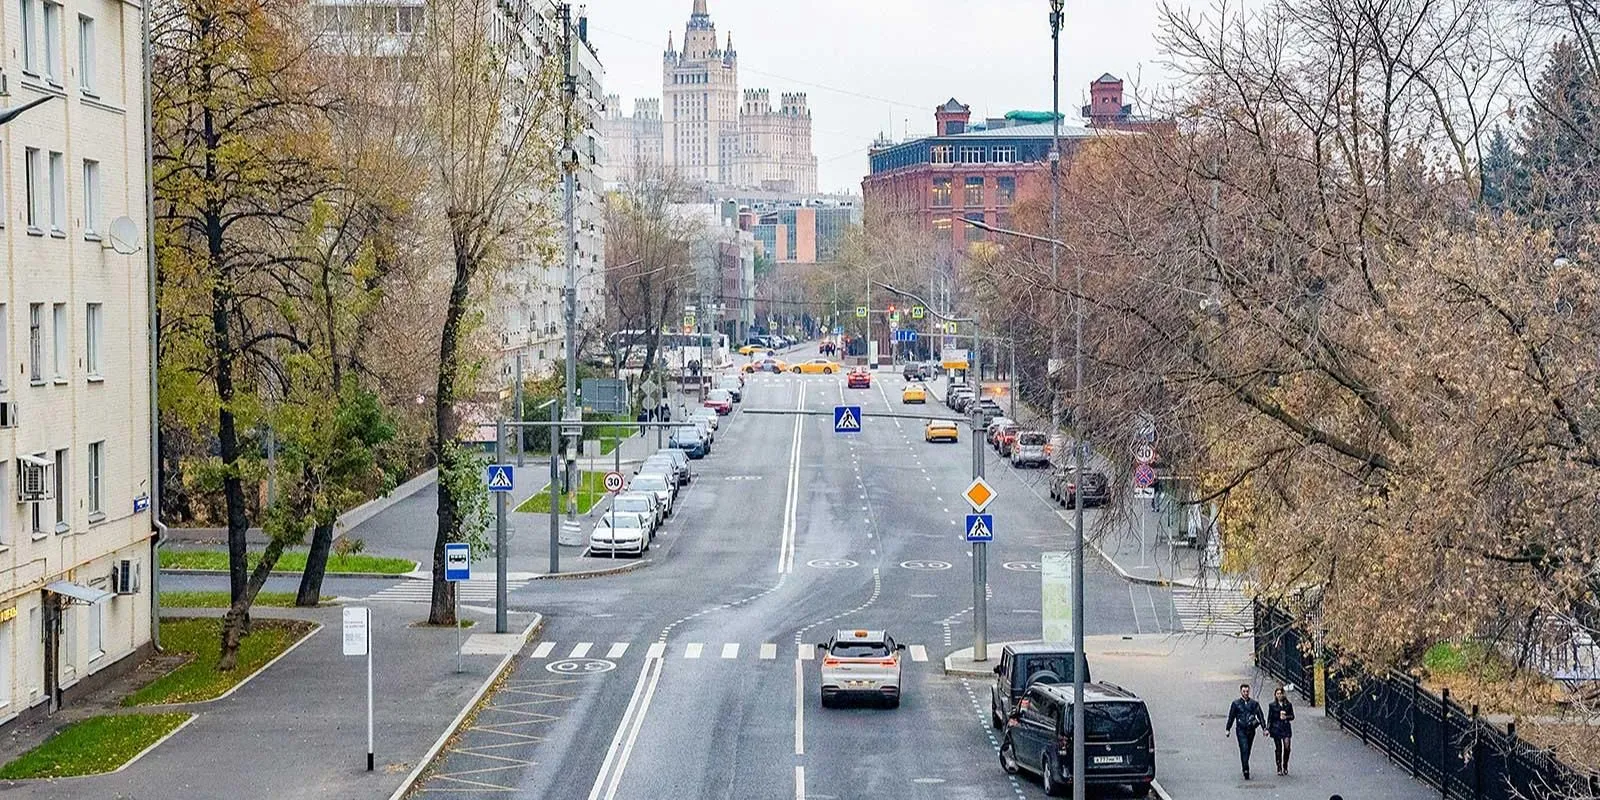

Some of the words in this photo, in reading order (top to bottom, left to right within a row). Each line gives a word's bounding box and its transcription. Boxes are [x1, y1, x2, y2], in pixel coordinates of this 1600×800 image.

[1138, 450, 1151, 458] 30
[607, 477, 620, 487] 30
[556, 662, 606, 671] 30
